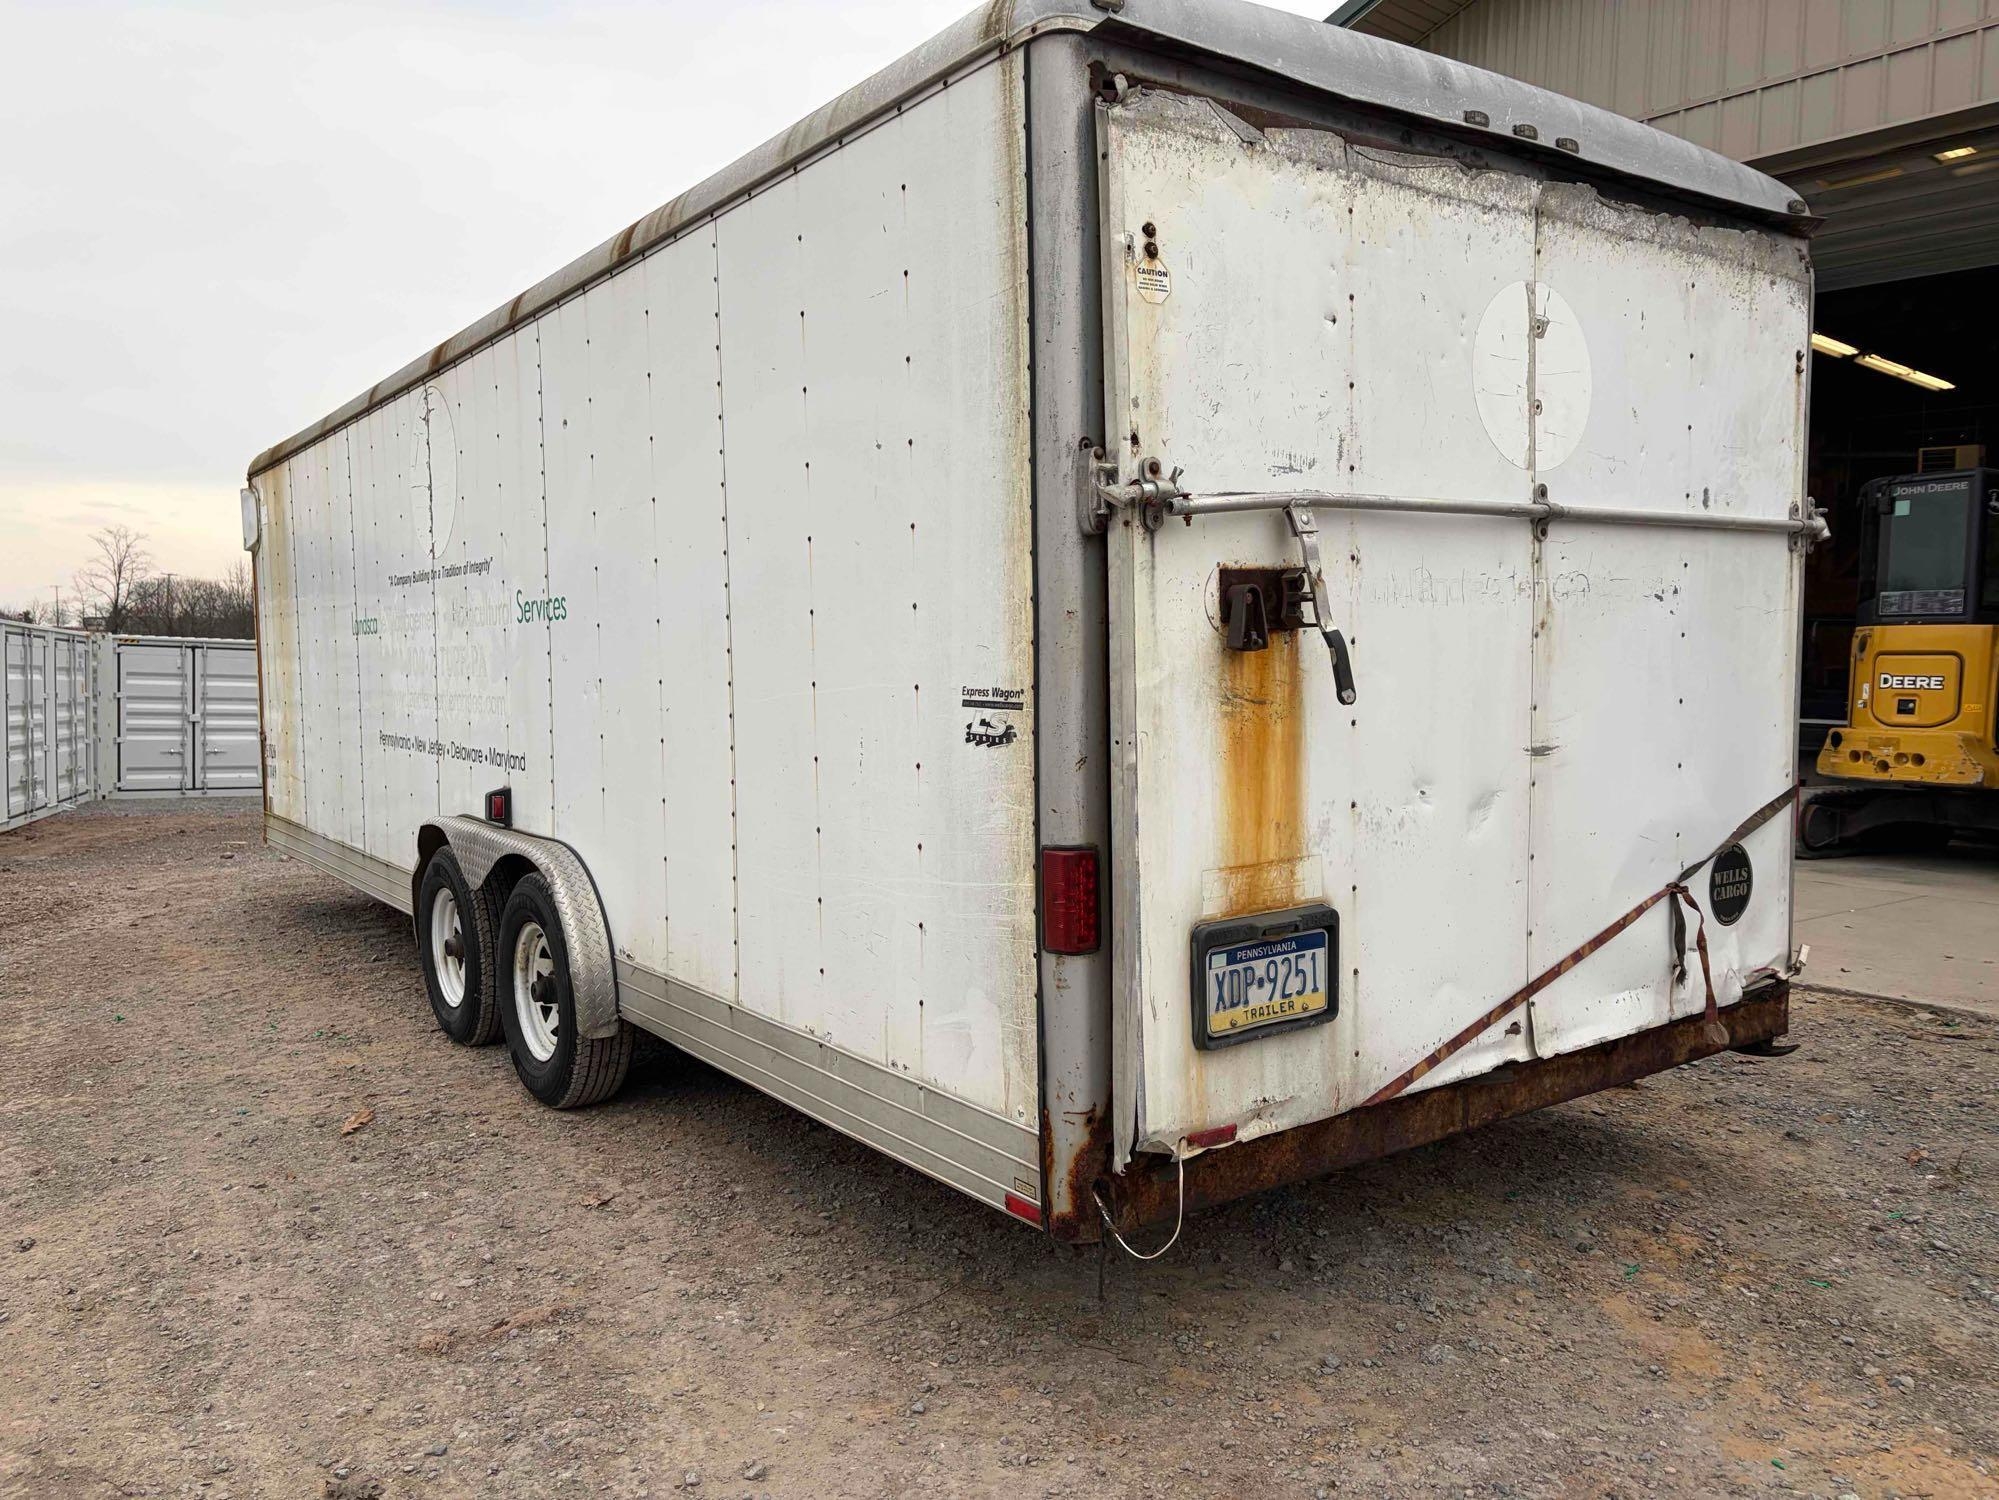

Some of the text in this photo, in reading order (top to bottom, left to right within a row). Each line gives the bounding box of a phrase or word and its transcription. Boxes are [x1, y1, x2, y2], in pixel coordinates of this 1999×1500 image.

[1137, 267, 1168, 278] CAUTION
[1893, 481, 1968, 497] JOHN DEERE
[394, 574, 411, 587] Company
[412, 569, 430, 584] Building
[441, 564, 462, 578] Tradition
[462, 560, 469, 576] of
[516, 589, 567, 624] Services
[1879, 672, 1944, 689] DEERE
[962, 685, 990, 698] Express
[970, 734, 1007, 744] SERIES
[379, 730, 526, 772] Pennsylvania New Jersey Delaware Maryland
[1714, 867, 1749, 886] WELLS
[1713, 882, 1748, 901] CARGO
[1236, 940, 1297, 960] PENNSYLVANIA
[1243, 1000, 1296, 1020] TRAILER
